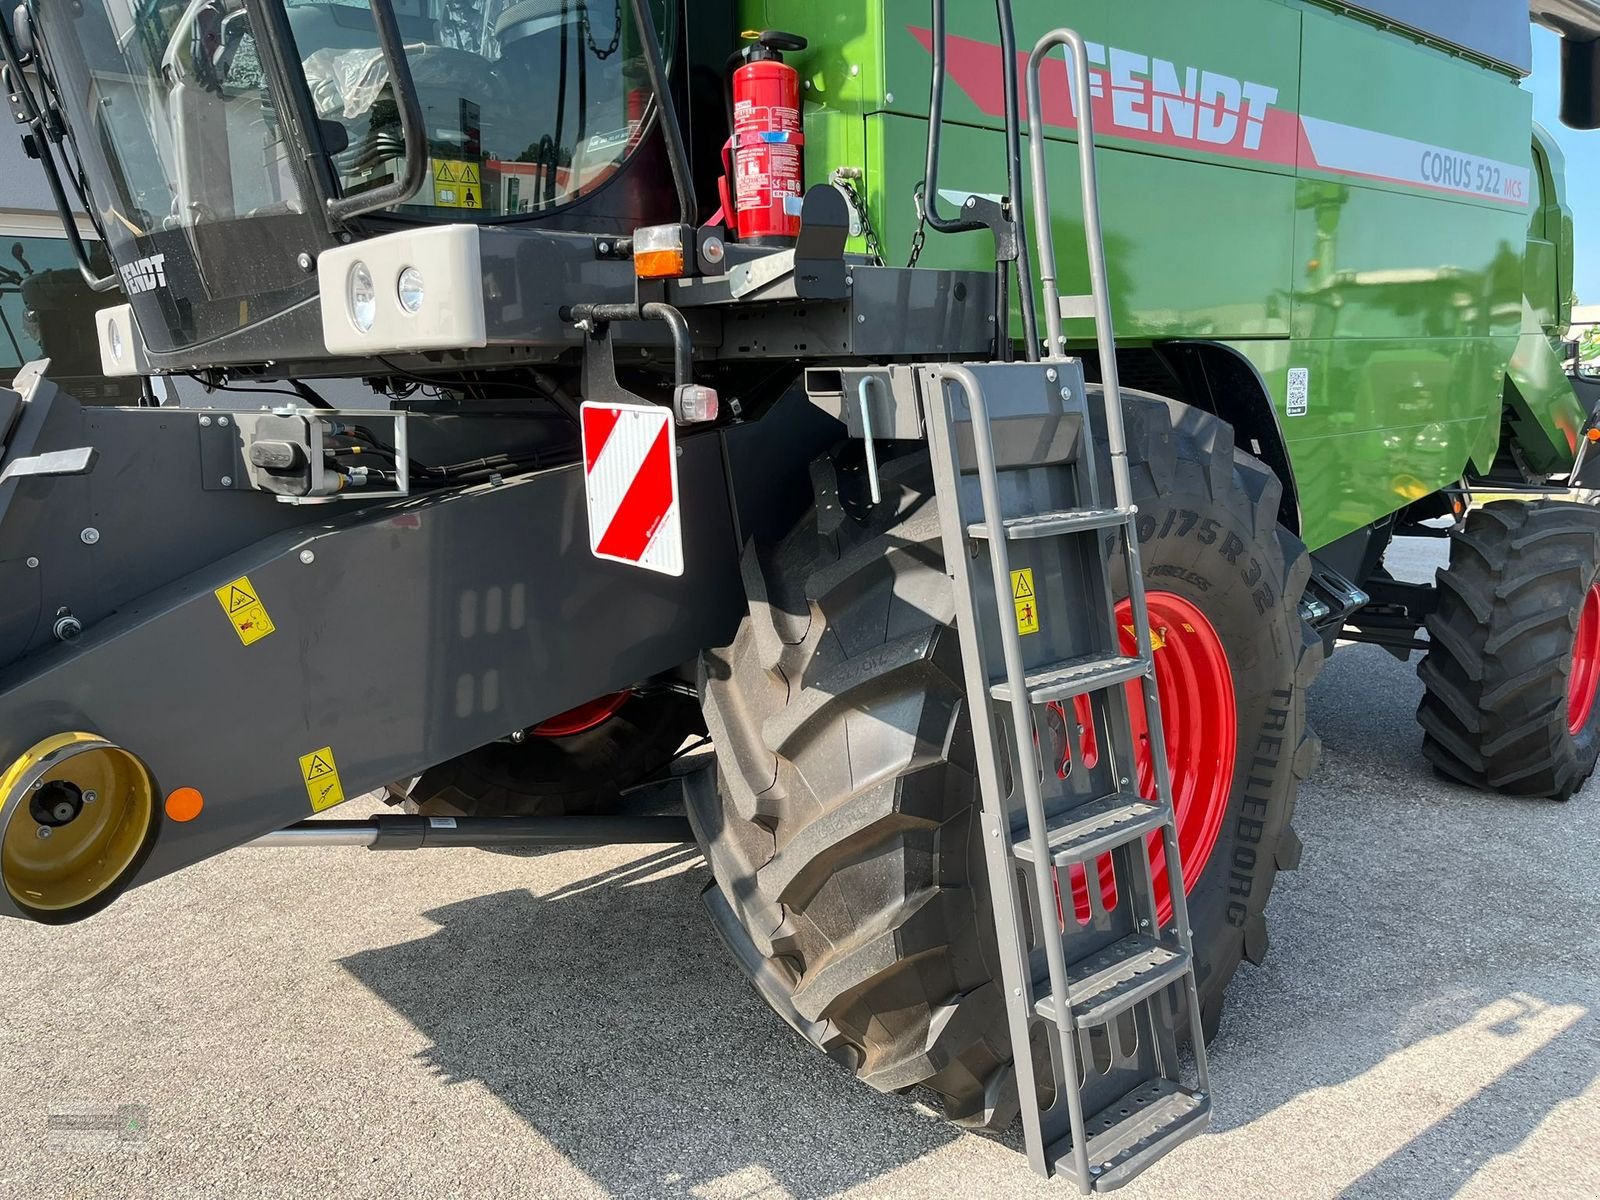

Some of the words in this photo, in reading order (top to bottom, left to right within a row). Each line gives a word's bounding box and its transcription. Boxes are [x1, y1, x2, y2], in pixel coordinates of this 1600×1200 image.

[1063, 41, 1279, 150] FENDT
[1421, 150, 1472, 189] CORUS
[1476, 164, 1501, 194] 522
[1503, 178, 1522, 198] MCS
[119, 253, 167, 295] FENDT
[1225, 682, 1293, 929] TRELLEBORG
